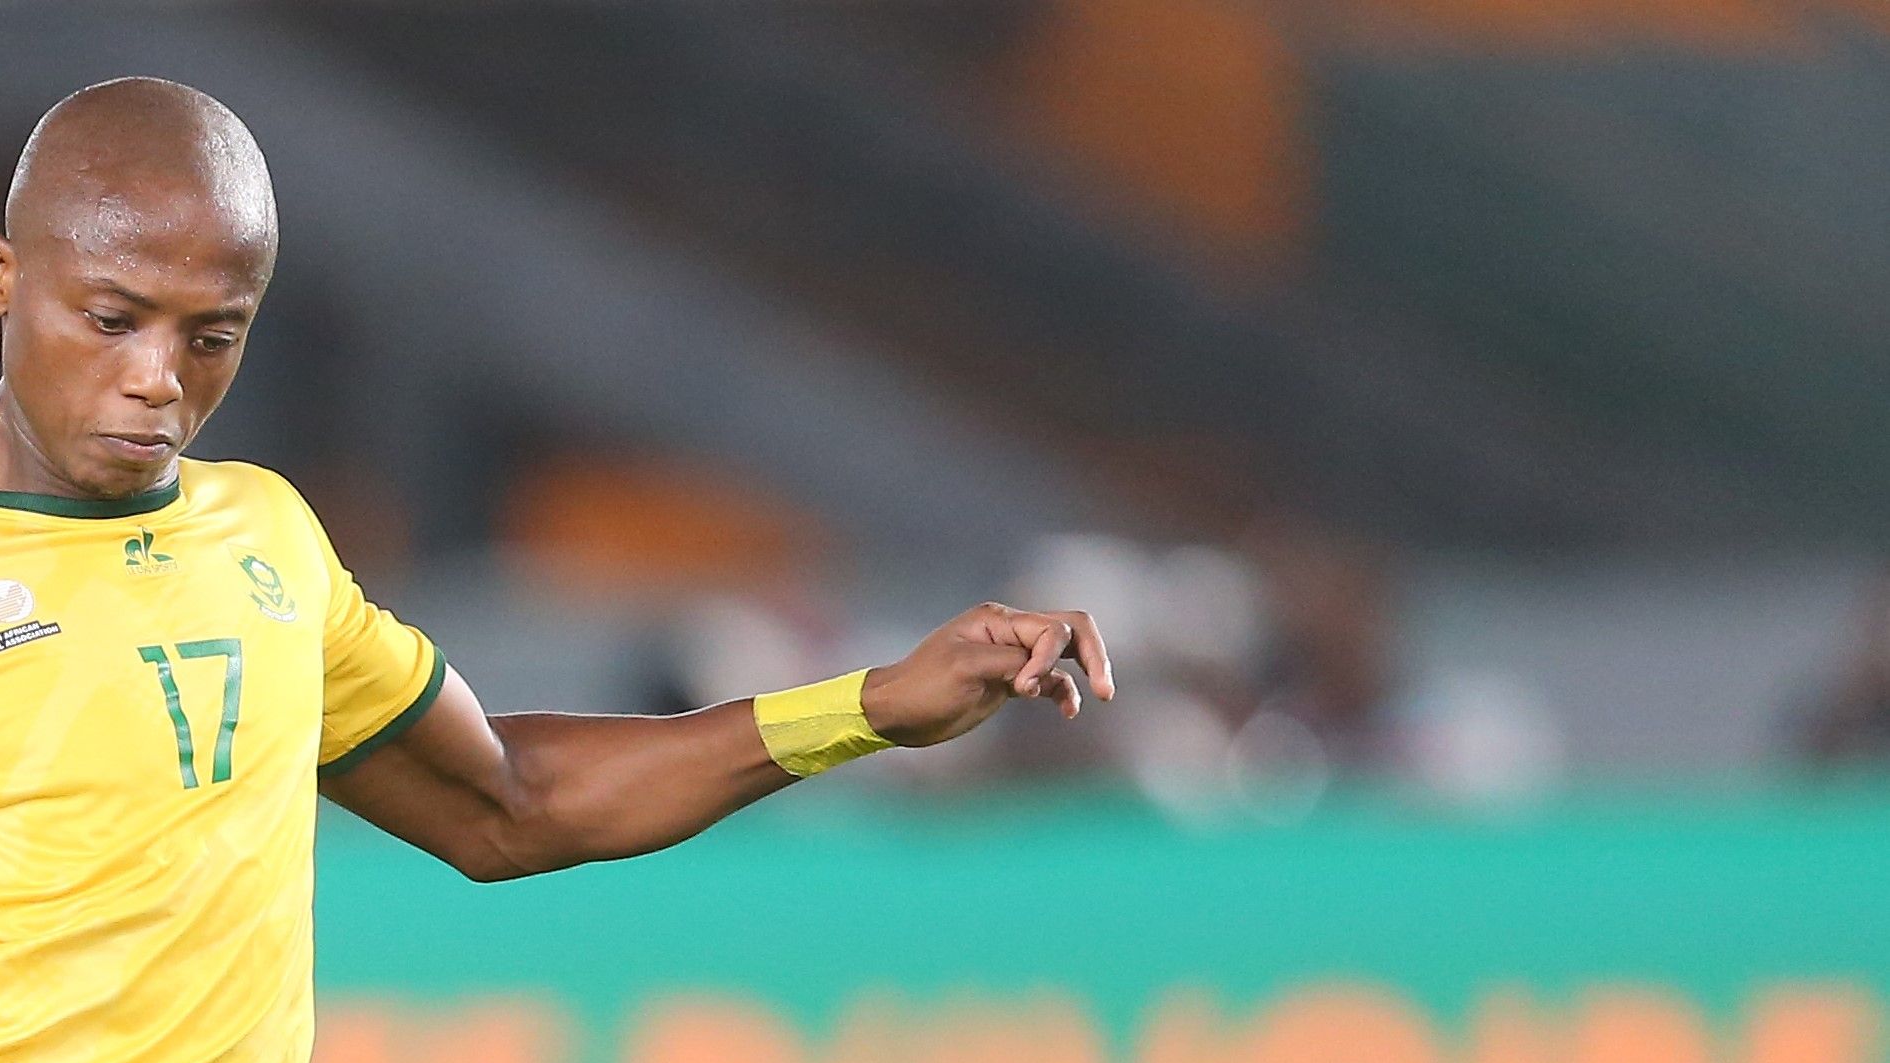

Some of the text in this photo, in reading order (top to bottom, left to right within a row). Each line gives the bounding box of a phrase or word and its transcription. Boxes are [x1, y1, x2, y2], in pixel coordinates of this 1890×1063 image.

[3, 622, 40, 639] AFRICAN
[5, 625, 59, 647] ASSOCIATION
[137, 637, 242, 790] 17
